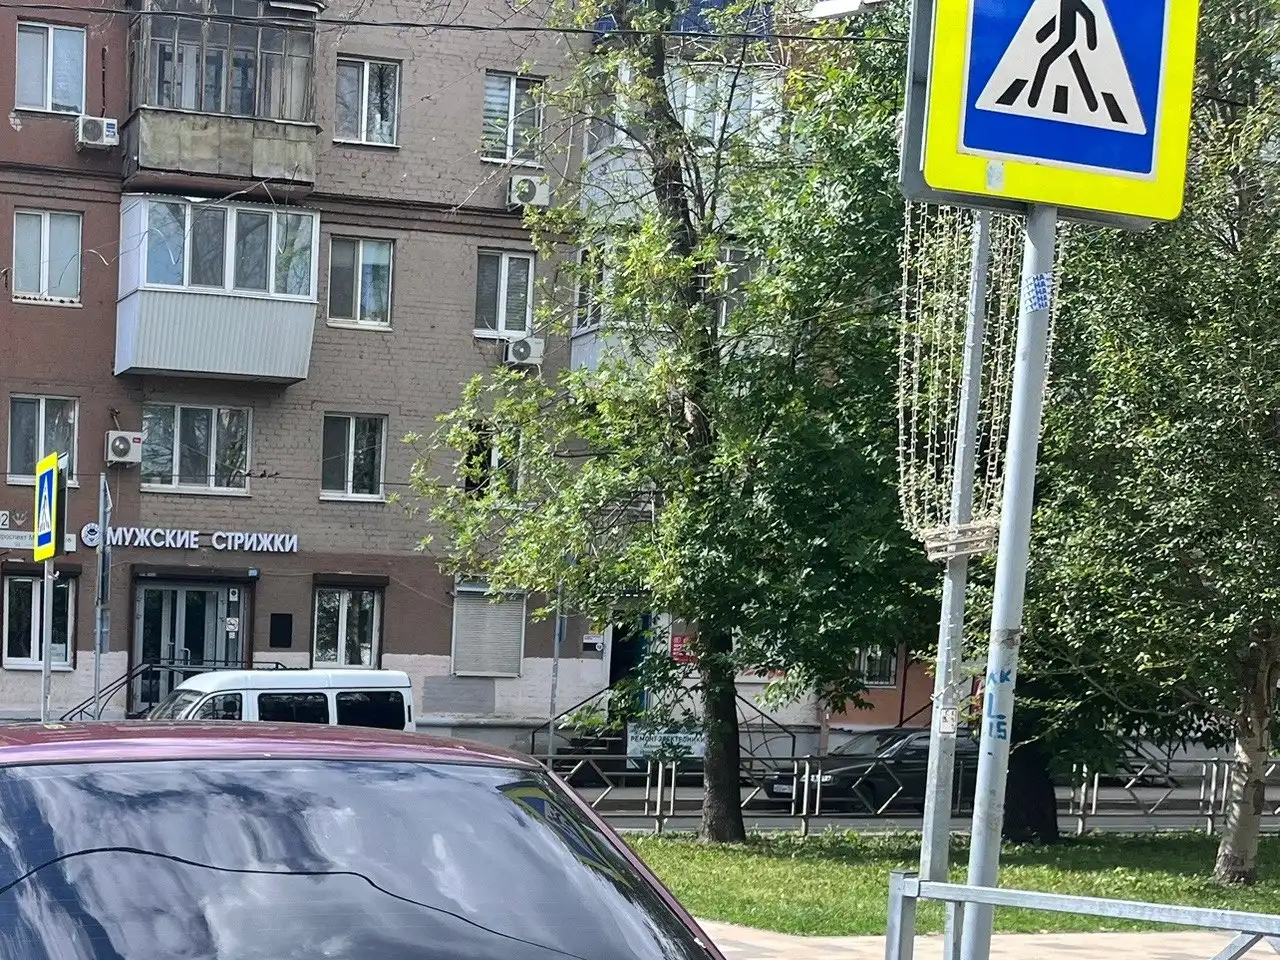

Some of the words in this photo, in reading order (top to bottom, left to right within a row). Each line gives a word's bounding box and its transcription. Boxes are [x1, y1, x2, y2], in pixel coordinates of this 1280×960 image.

[105, 527, 199, 548] МУЖСКИЕ
[211, 531, 298, 552] СТРИЖКИ
[630, 735, 657, 743] РЕМОНТ
